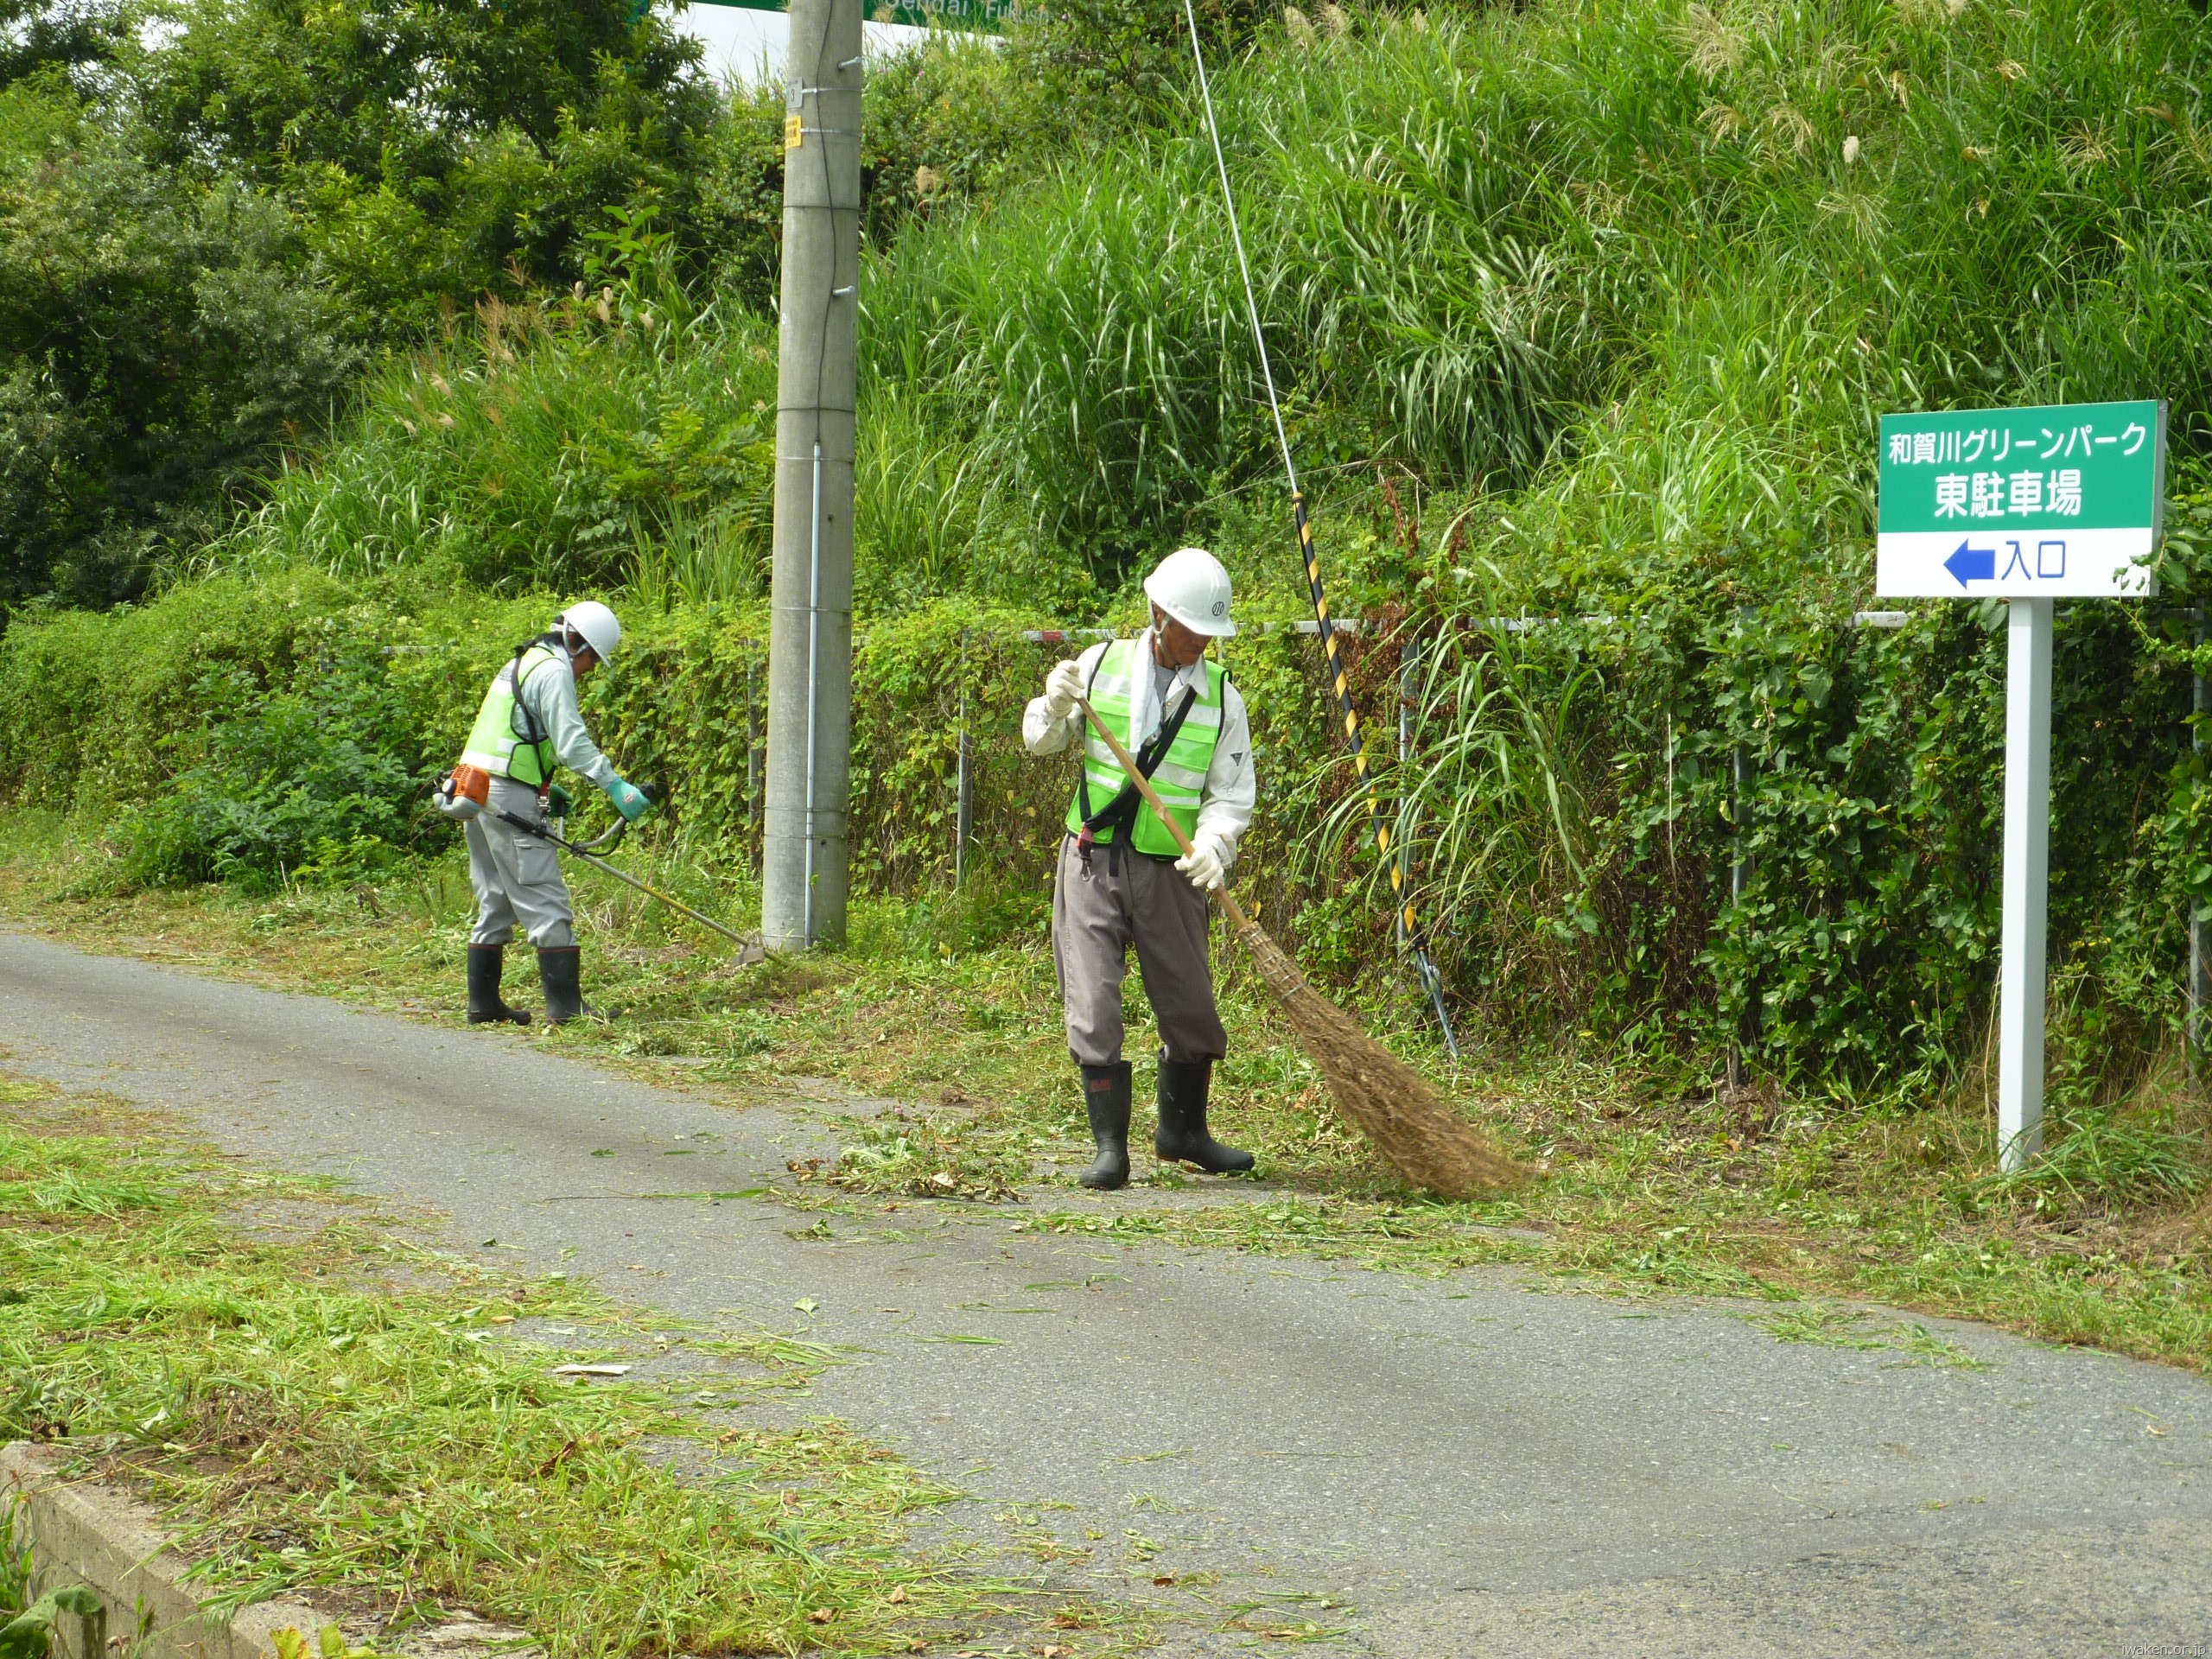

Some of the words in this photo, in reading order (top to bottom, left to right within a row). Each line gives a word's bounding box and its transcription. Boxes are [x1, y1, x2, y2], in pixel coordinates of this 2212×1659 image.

[1889, 422, 2146, 464] 和賀川グリーンパーク
[1935, 468, 2082, 518] 東駐車場
[2001, 540, 2066, 581] 入口
